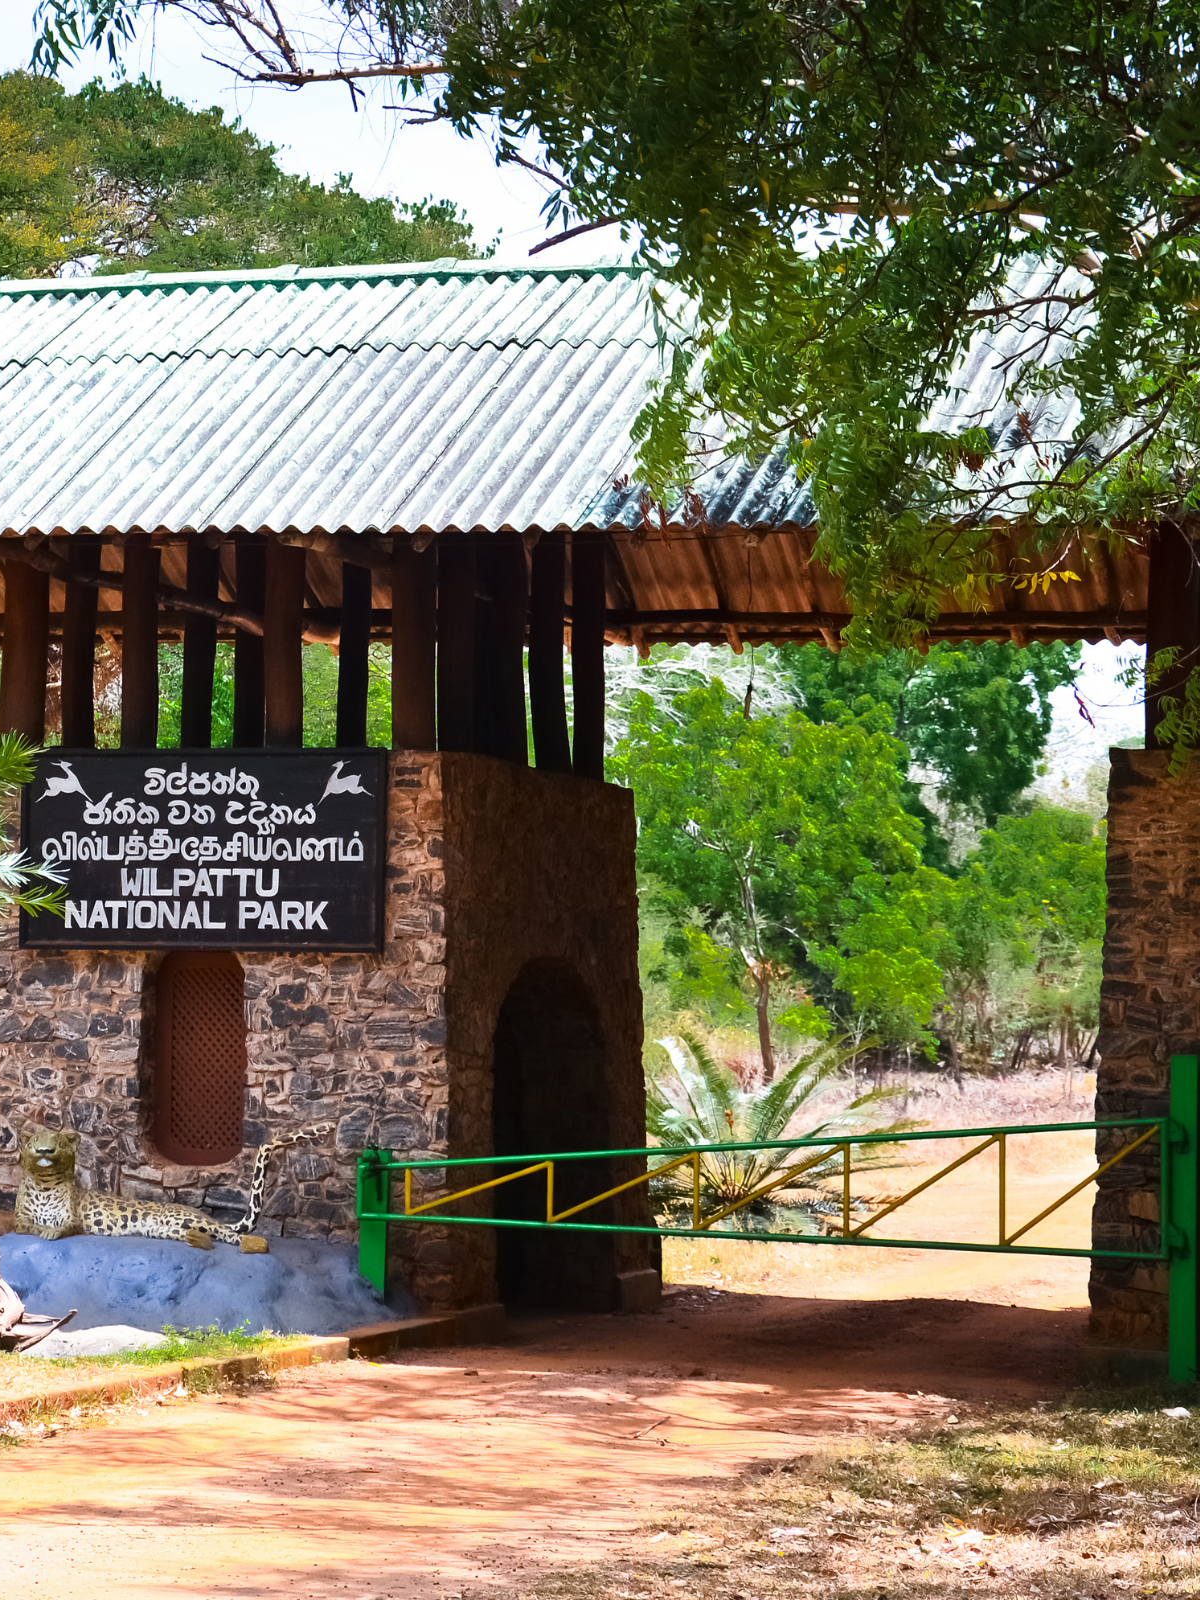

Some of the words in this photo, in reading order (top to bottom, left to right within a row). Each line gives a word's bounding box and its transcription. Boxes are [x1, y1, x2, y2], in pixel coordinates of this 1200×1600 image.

[82, 791, 161, 826] ජාතික
[167, 800, 216, 826] වන
[121, 867, 280, 898] WILPATTU
[64, 899, 227, 931] NATIONAL
[238, 900, 329, 931] PARK
